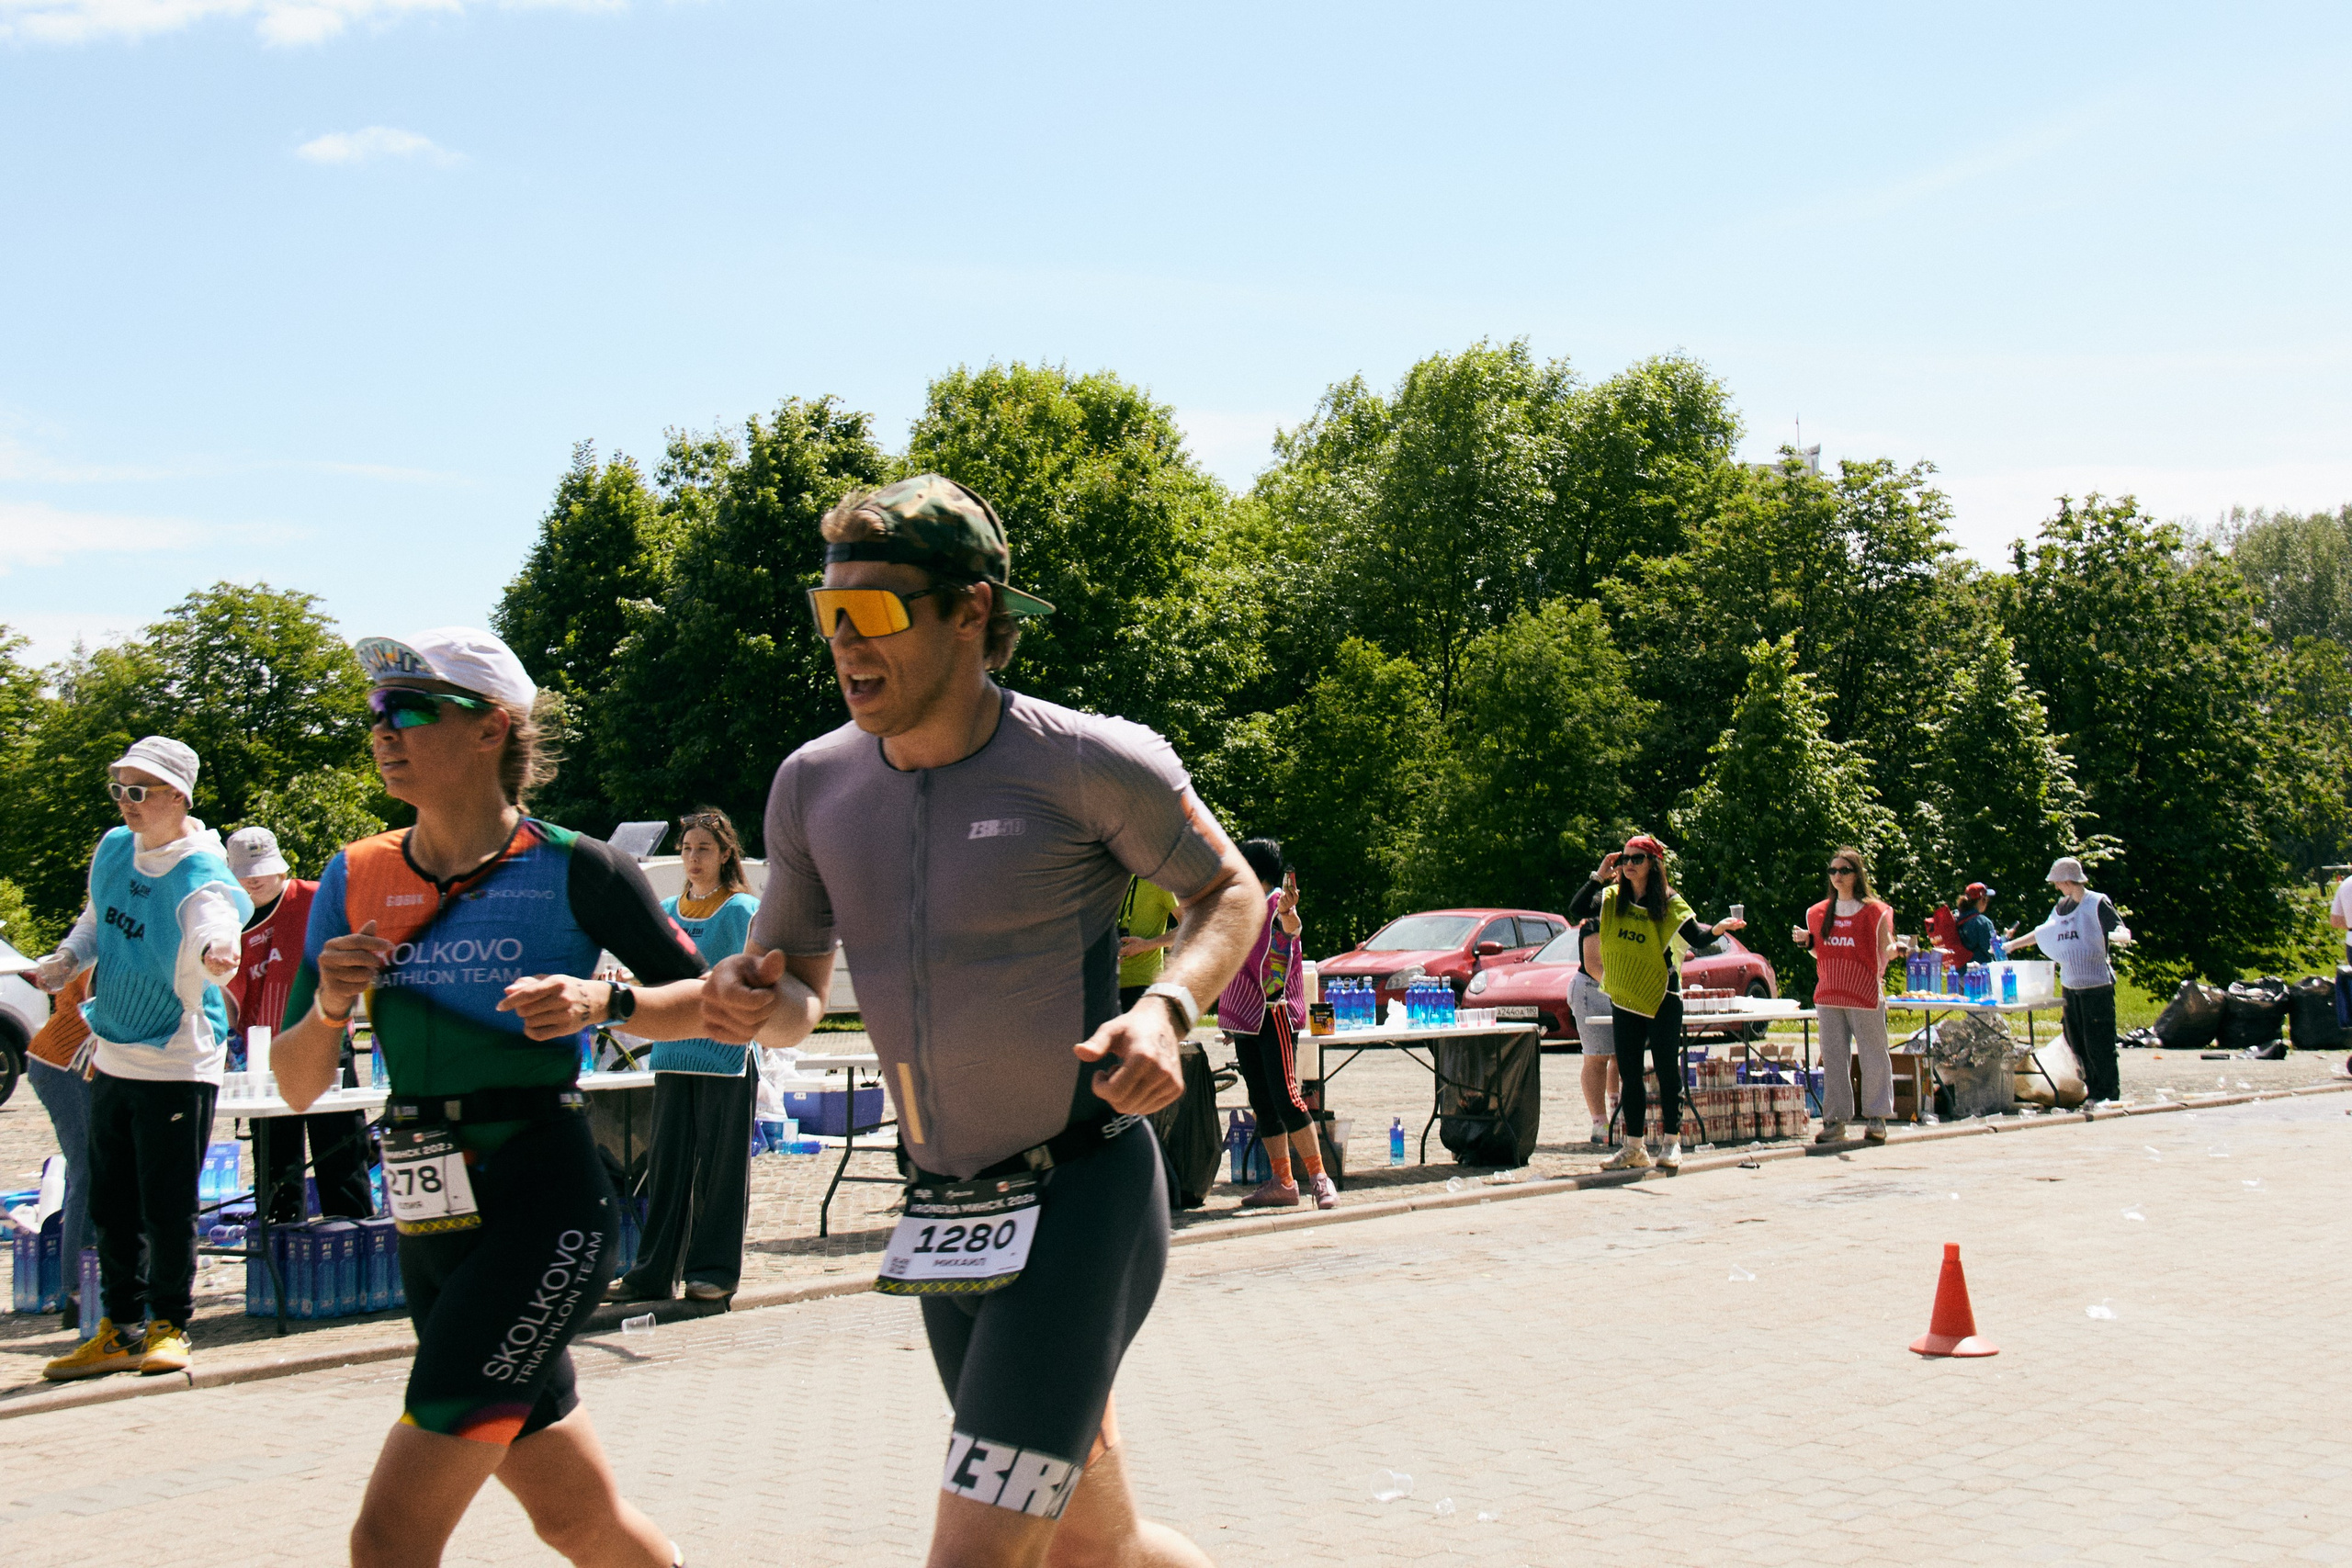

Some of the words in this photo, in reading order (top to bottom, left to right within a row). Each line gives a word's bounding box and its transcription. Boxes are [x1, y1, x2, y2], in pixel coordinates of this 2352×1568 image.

[1618, 928, 1645, 943] ИЗО
[249, 947, 283, 981] КОА
[460, 966, 523, 984] TEAM
[913, 1219, 1017, 1254] 1280
[482, 1229, 585, 1382] SKOLKOVO
[512, 1290, 582, 1384] TRIATHLON
[574, 1231, 605, 1284] TEAM
